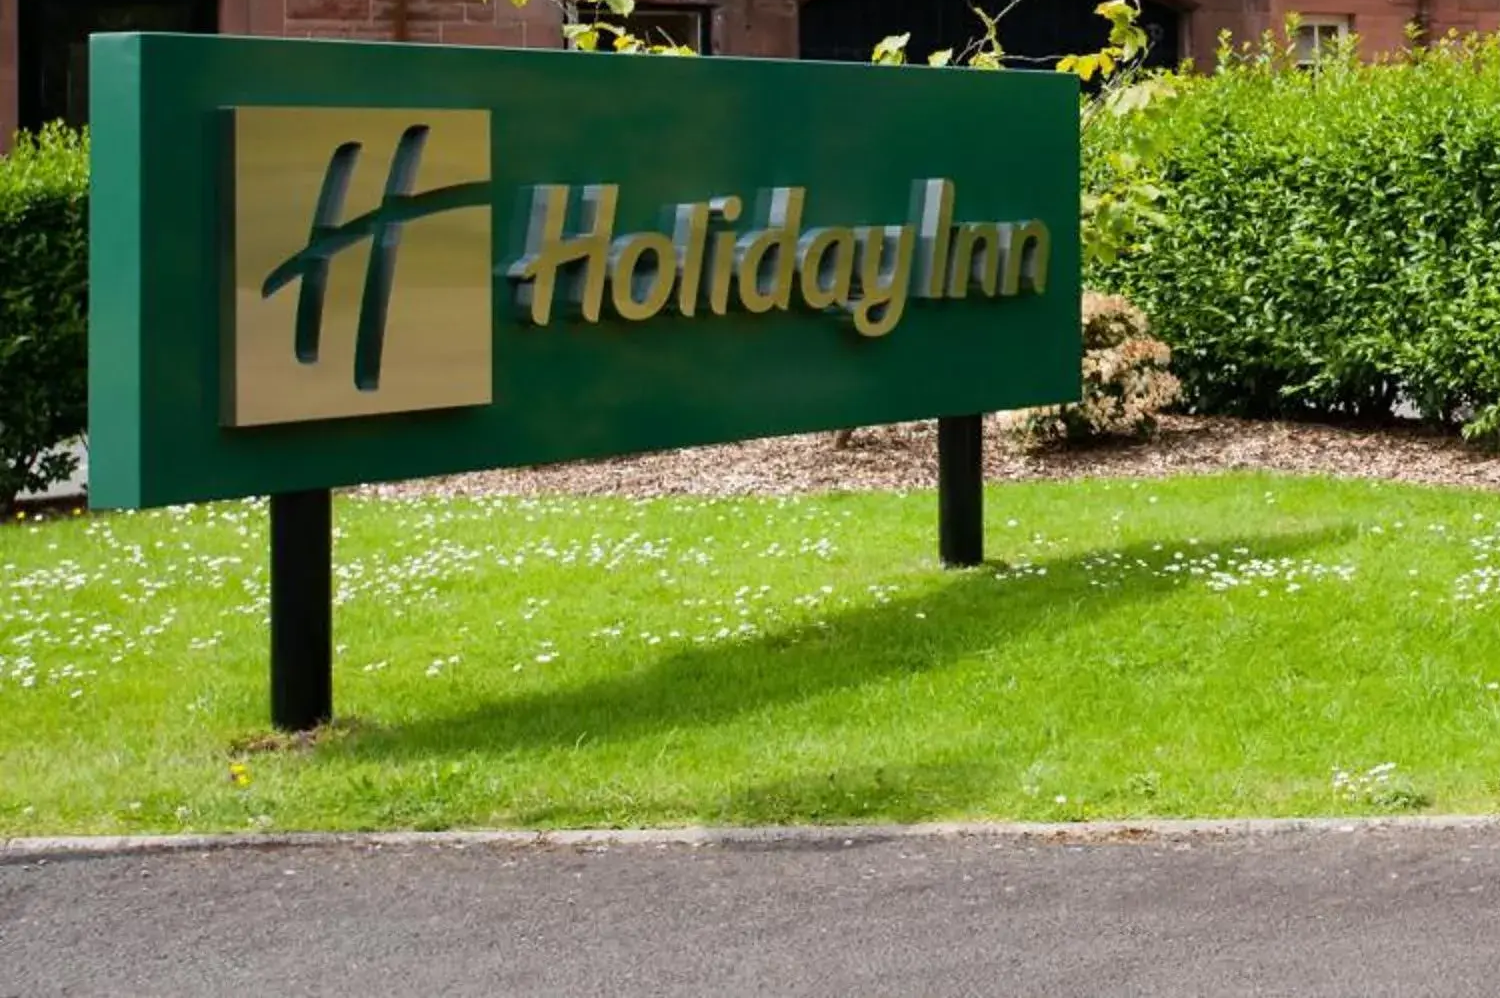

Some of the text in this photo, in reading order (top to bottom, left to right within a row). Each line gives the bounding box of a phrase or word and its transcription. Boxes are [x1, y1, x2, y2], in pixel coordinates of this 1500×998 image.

[262, 123, 491, 392] H
[508, 178, 1050, 337] Holiday Inn
